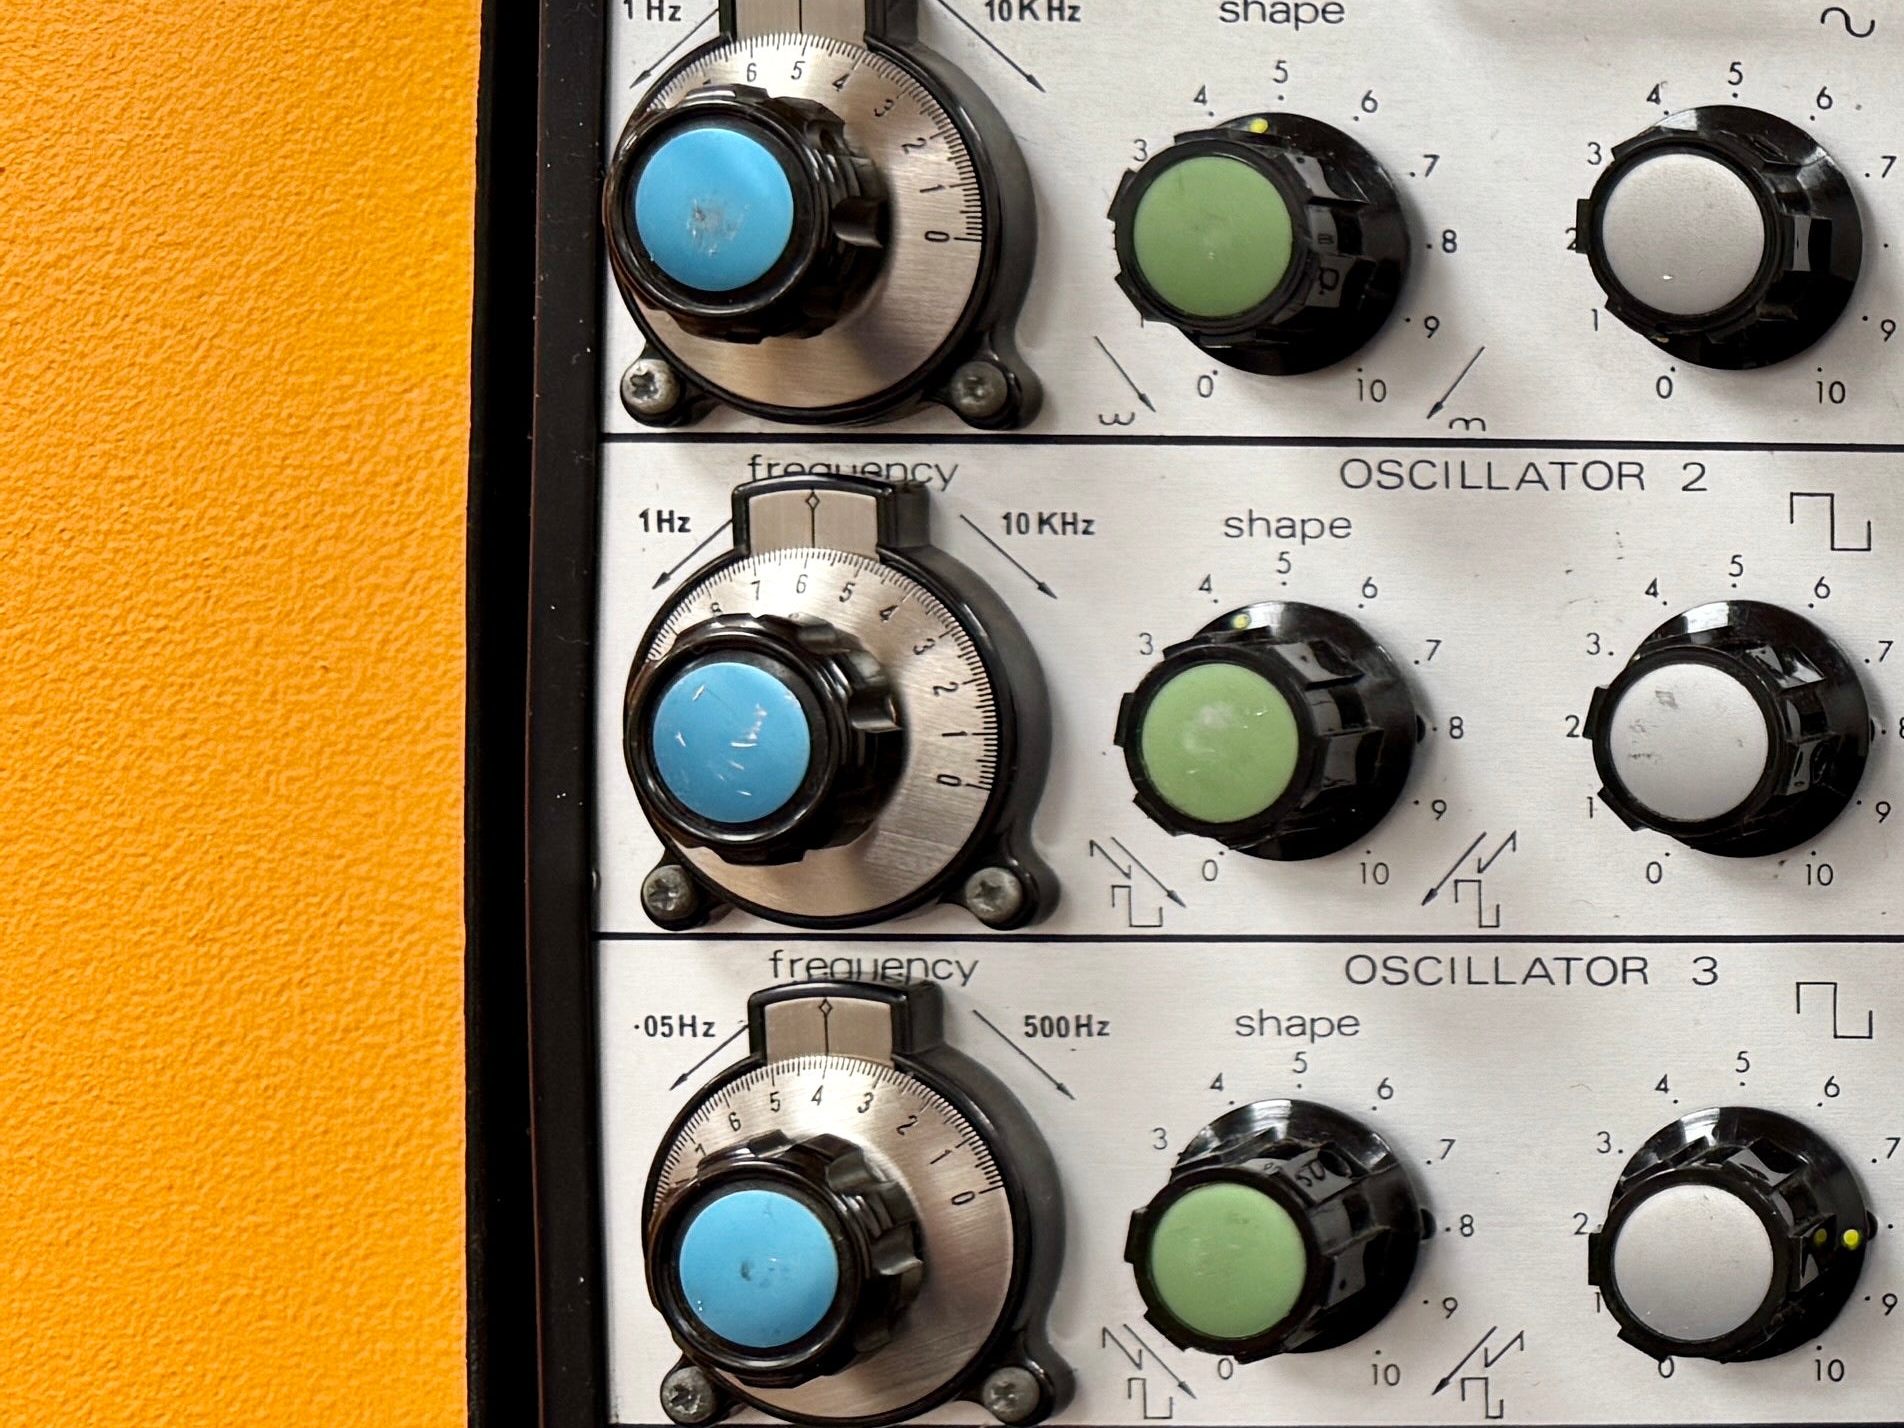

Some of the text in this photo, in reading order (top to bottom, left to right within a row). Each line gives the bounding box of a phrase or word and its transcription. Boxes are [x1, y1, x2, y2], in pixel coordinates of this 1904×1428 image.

[1339, 457, 1708, 492] OSCILLATOR 2
[638, 507, 692, 534] 1Hz
[1344, 954, 1719, 987] OSCILLATOR 3
[1023, 1013, 1110, 1039] 500Hz
